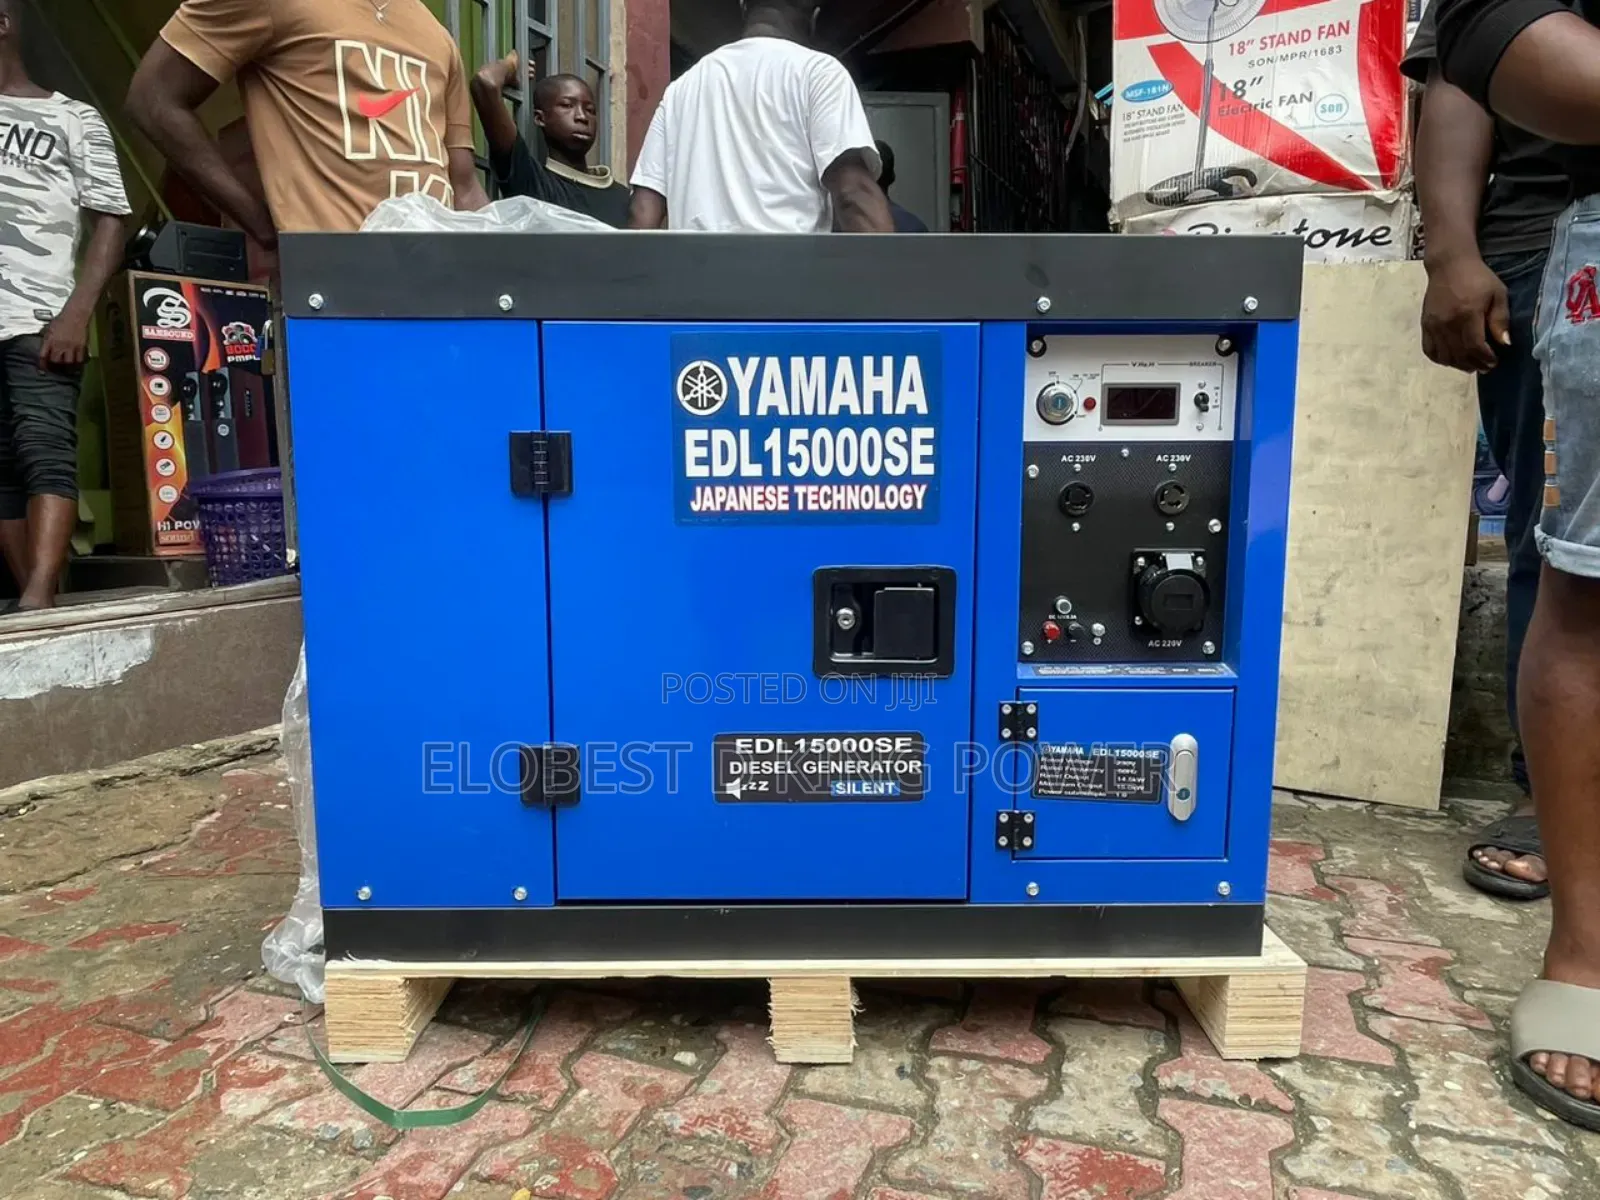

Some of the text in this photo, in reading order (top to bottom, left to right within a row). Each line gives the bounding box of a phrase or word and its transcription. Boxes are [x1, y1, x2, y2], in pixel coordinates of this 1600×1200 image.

[1259, 29, 1311, 51] STAND
[1317, 20, 1350, 40] FAN
[1248, 45, 1342, 68] SON/MPR/1683
[1218, 91, 1313, 116] Electric FAN
[1137, 105, 1165, 119] STAND
[727, 355, 928, 416] YAMAHA
[685, 426, 935, 477] EDL15000SE
[1060, 454, 1074, 463] AC
[1155, 454, 1169, 463] AC
[690, 483, 928, 512] JAPANESE TECHNOLOGY
[1148, 639, 1161, 647] AC
[736, 738, 912, 754] EDL15000SE
[1092, 748, 1160, 759] EDL15000SE
[729, 759, 922, 775] DIESEL GENERATOR
[835, 782, 896, 795] SILENT
